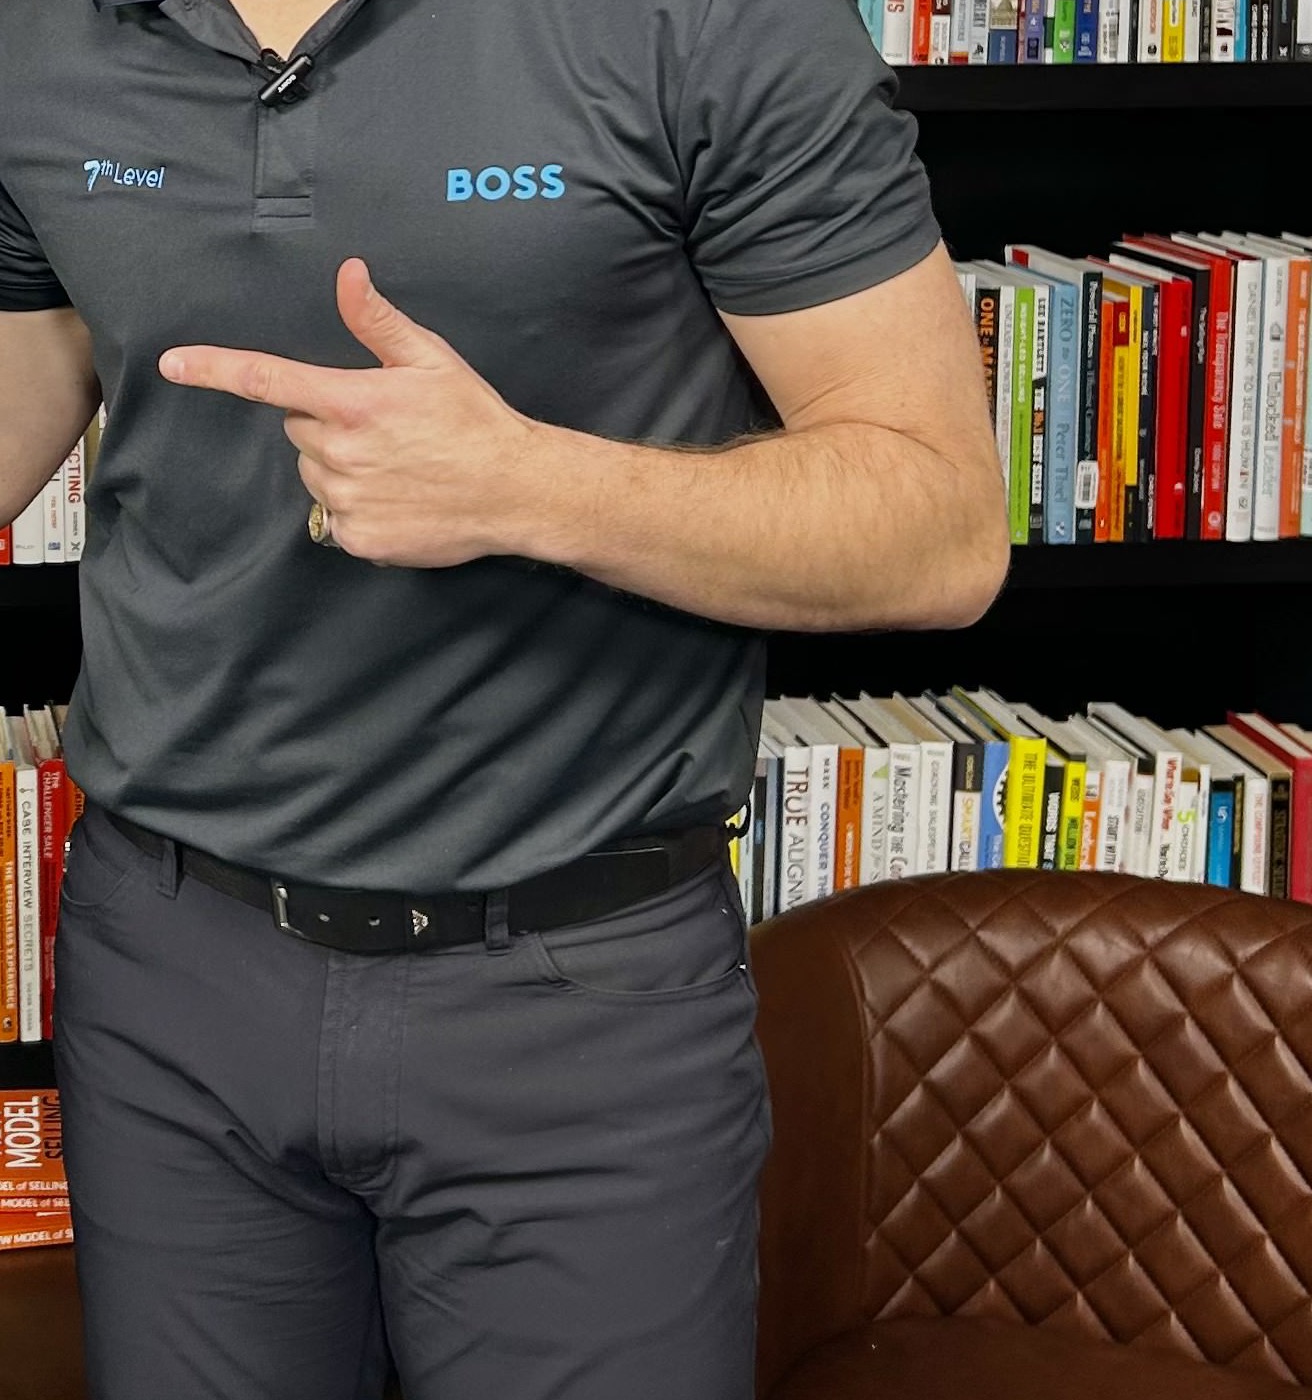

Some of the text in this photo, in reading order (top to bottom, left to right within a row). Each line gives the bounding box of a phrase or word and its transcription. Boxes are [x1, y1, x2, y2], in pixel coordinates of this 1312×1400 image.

[114, 165, 165, 190] Level
[447, 164, 566, 202] BOSS
[785, 768, 809, 827] TRUE
[3, 1096, 42, 1167] MODEL
